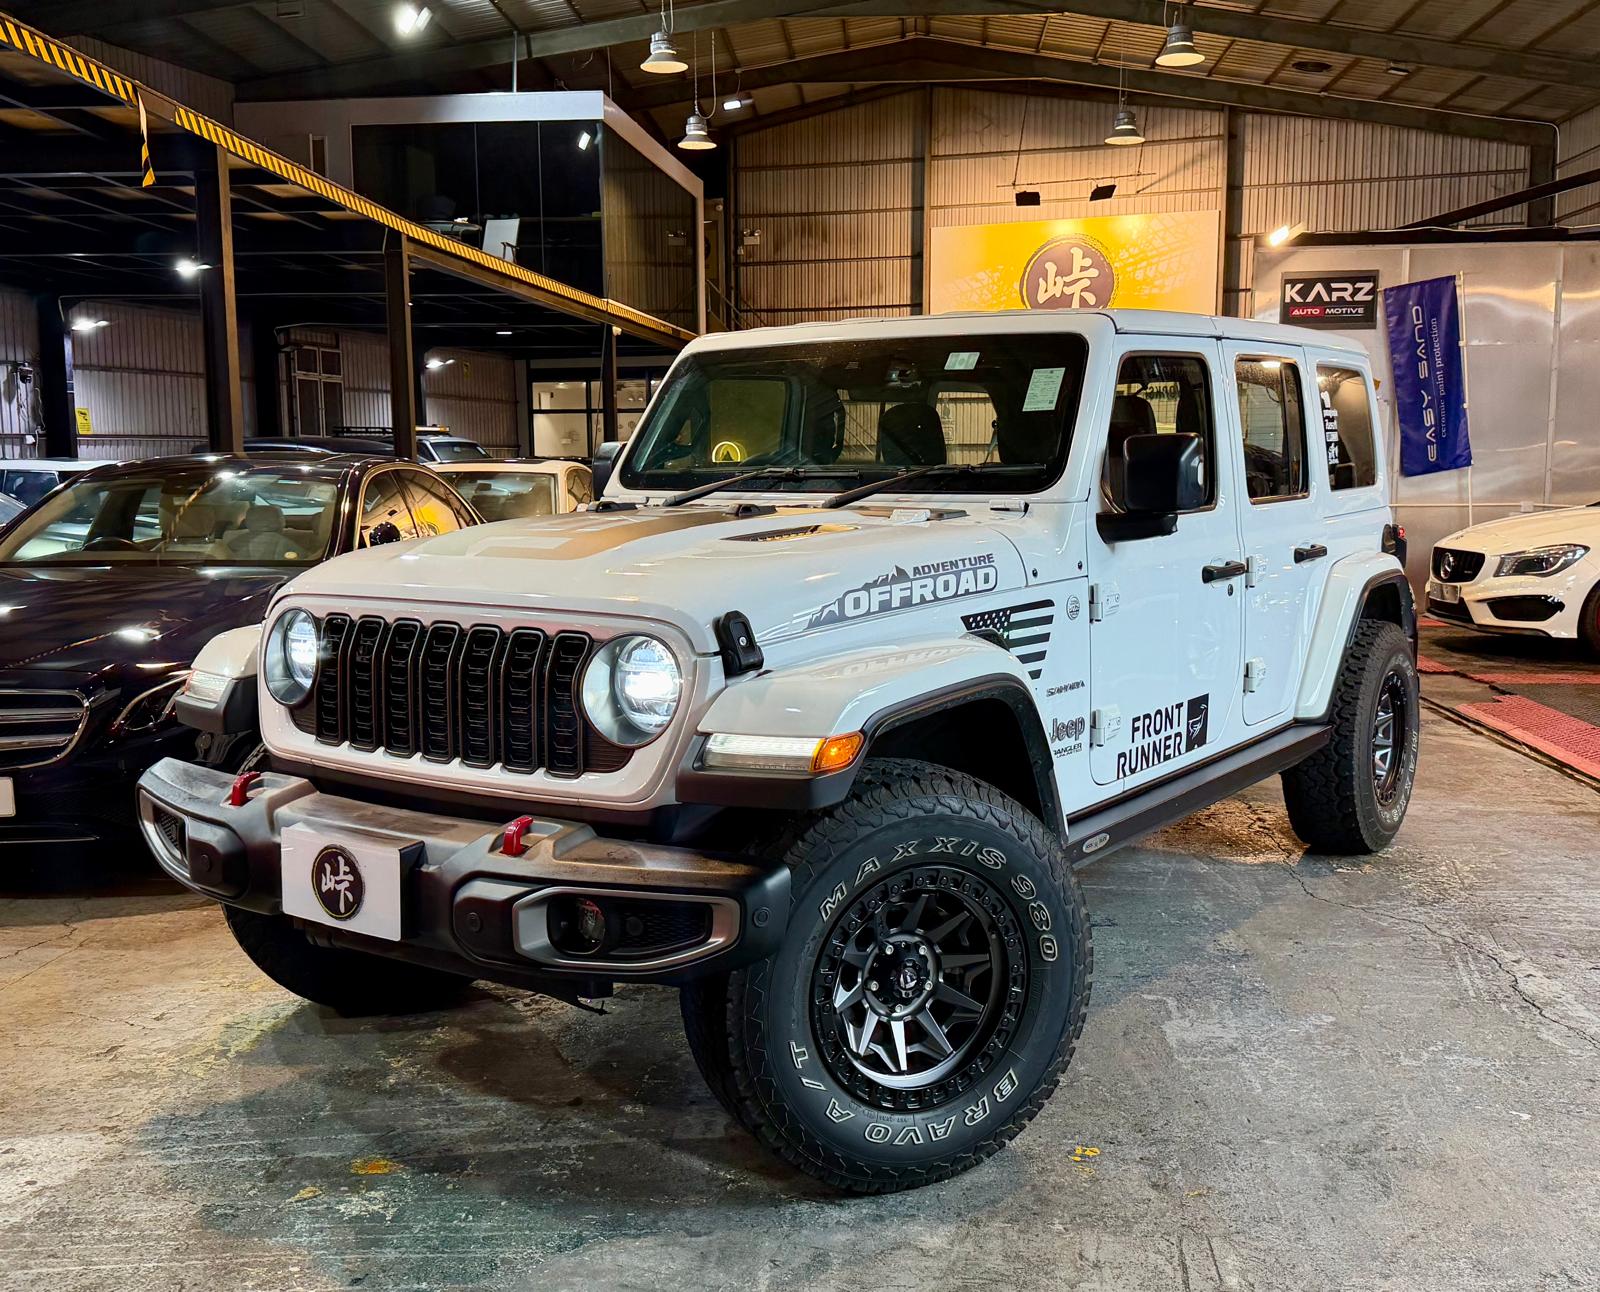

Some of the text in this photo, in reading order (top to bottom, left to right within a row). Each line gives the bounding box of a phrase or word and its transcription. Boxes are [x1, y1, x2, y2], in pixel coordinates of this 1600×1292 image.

[1037, 247, 1099, 308] 峠
[1284, 282, 1374, 302] KARZ
[1431, 318, 1444, 368] protection
[1411, 305, 1437, 462] EASY SAND
[1436, 370, 1446, 397] paint
[912, 553, 995, 578] ADVENTURE
[844, 566, 997, 618] OFFROAD
[1048, 716, 1086, 744] Jeep
[1131, 701, 1184, 743] FRONT
[1116, 731, 1183, 780] RUNNER
[321, 855, 354, 914] 峠
[819, 837, 1059, 962] MAXXIS 980
[789, 1041, 1020, 1145] BRAVO A/T
